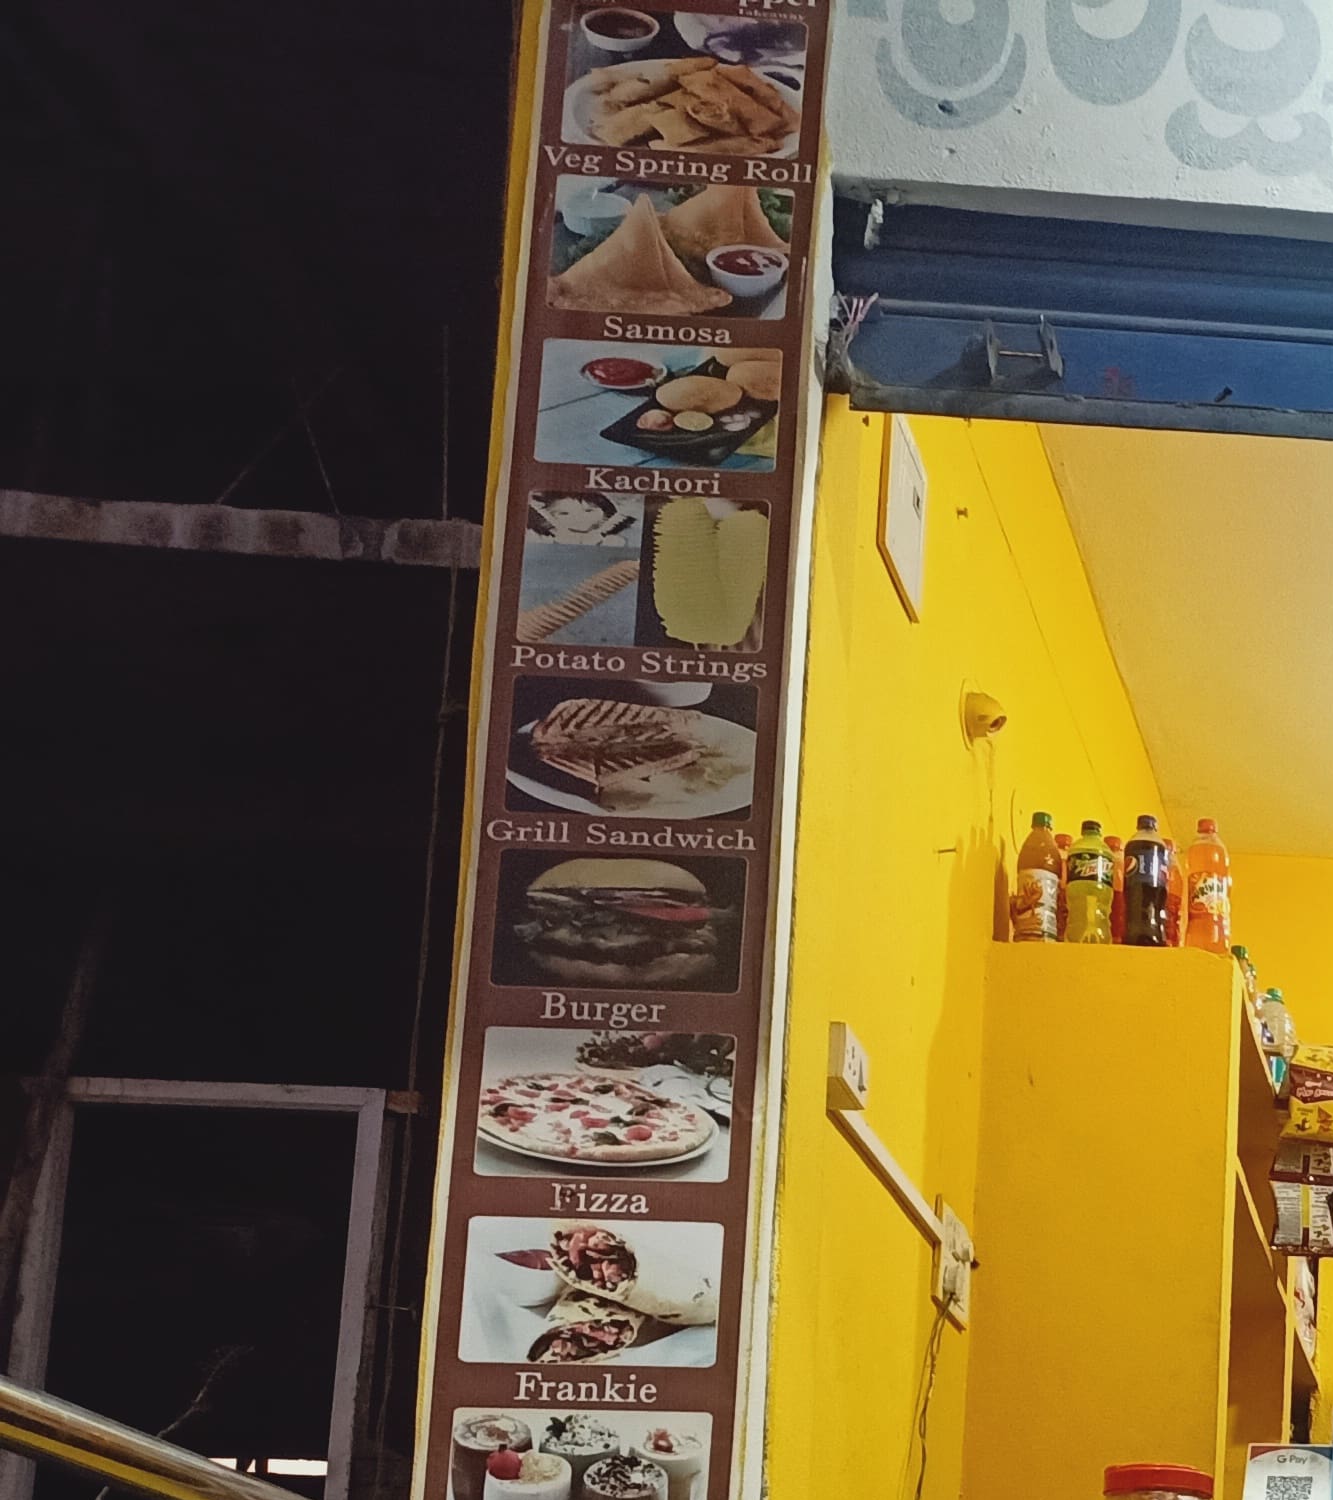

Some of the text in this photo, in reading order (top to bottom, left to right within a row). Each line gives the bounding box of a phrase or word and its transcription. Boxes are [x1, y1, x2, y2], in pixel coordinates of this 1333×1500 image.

[544, 145, 813, 184] Veg Spring Roll
[603, 316, 732, 345] Samosa
[585, 467, 721, 495] Kachori
[511, 645, 768, 682] Potato Strings
[486, 820, 756, 851] Grill Sandwich
[540, 992, 666, 1028] Burger
[514, 1371, 658, 1403] Frankie
[1289, 1454, 1308, 1465] Pay
